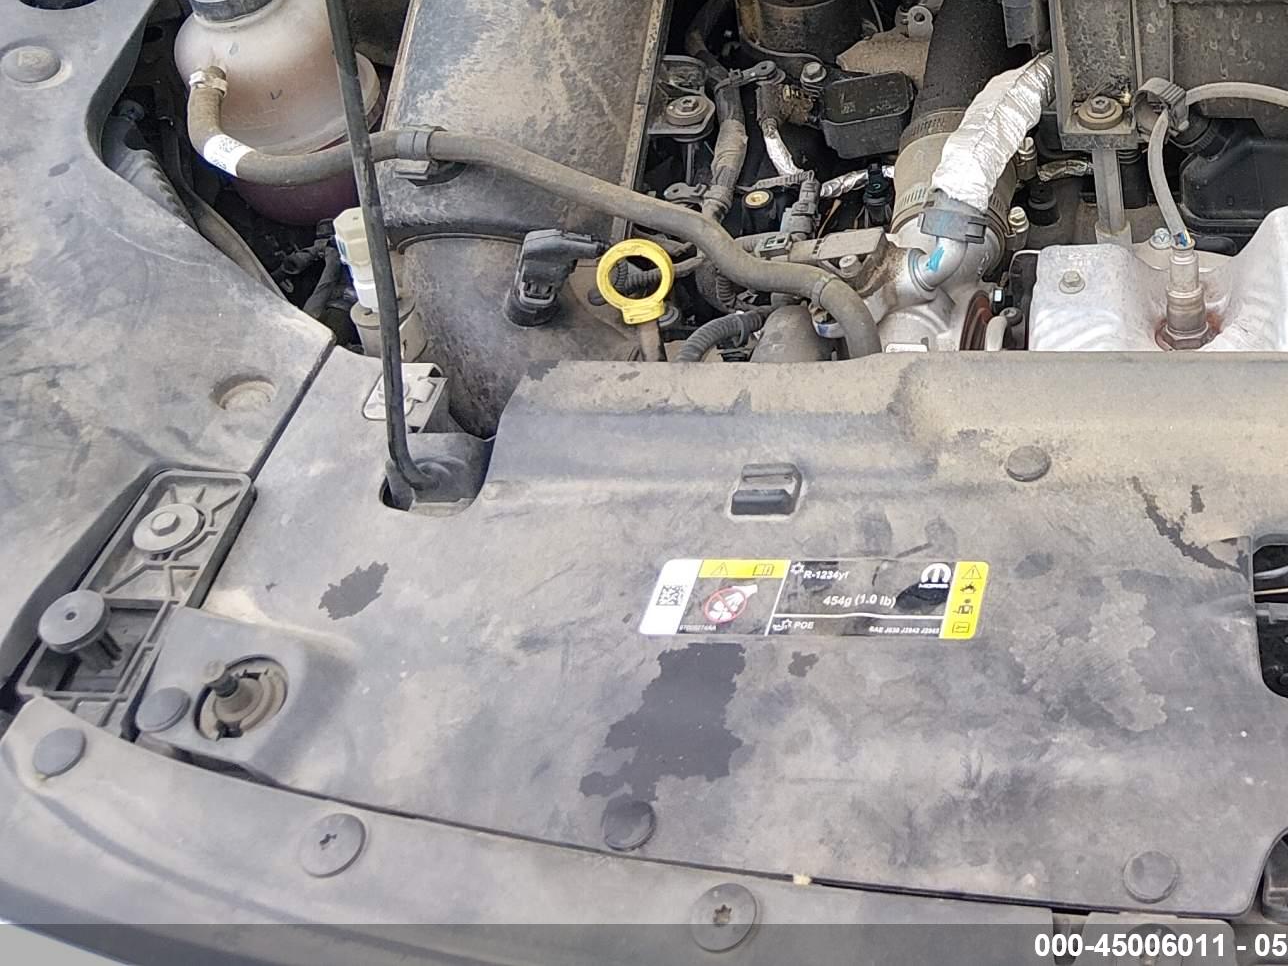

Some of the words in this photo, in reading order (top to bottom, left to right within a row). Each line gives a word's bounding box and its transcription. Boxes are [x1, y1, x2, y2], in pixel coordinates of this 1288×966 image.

[803, 570, 850, 581] R-1234yf
[823, 596, 852, 608] 454g
[854, 594, 878, 606] (1.0
[879, 595, 897, 608] lb)
[793, 621, 815, 629] POE
